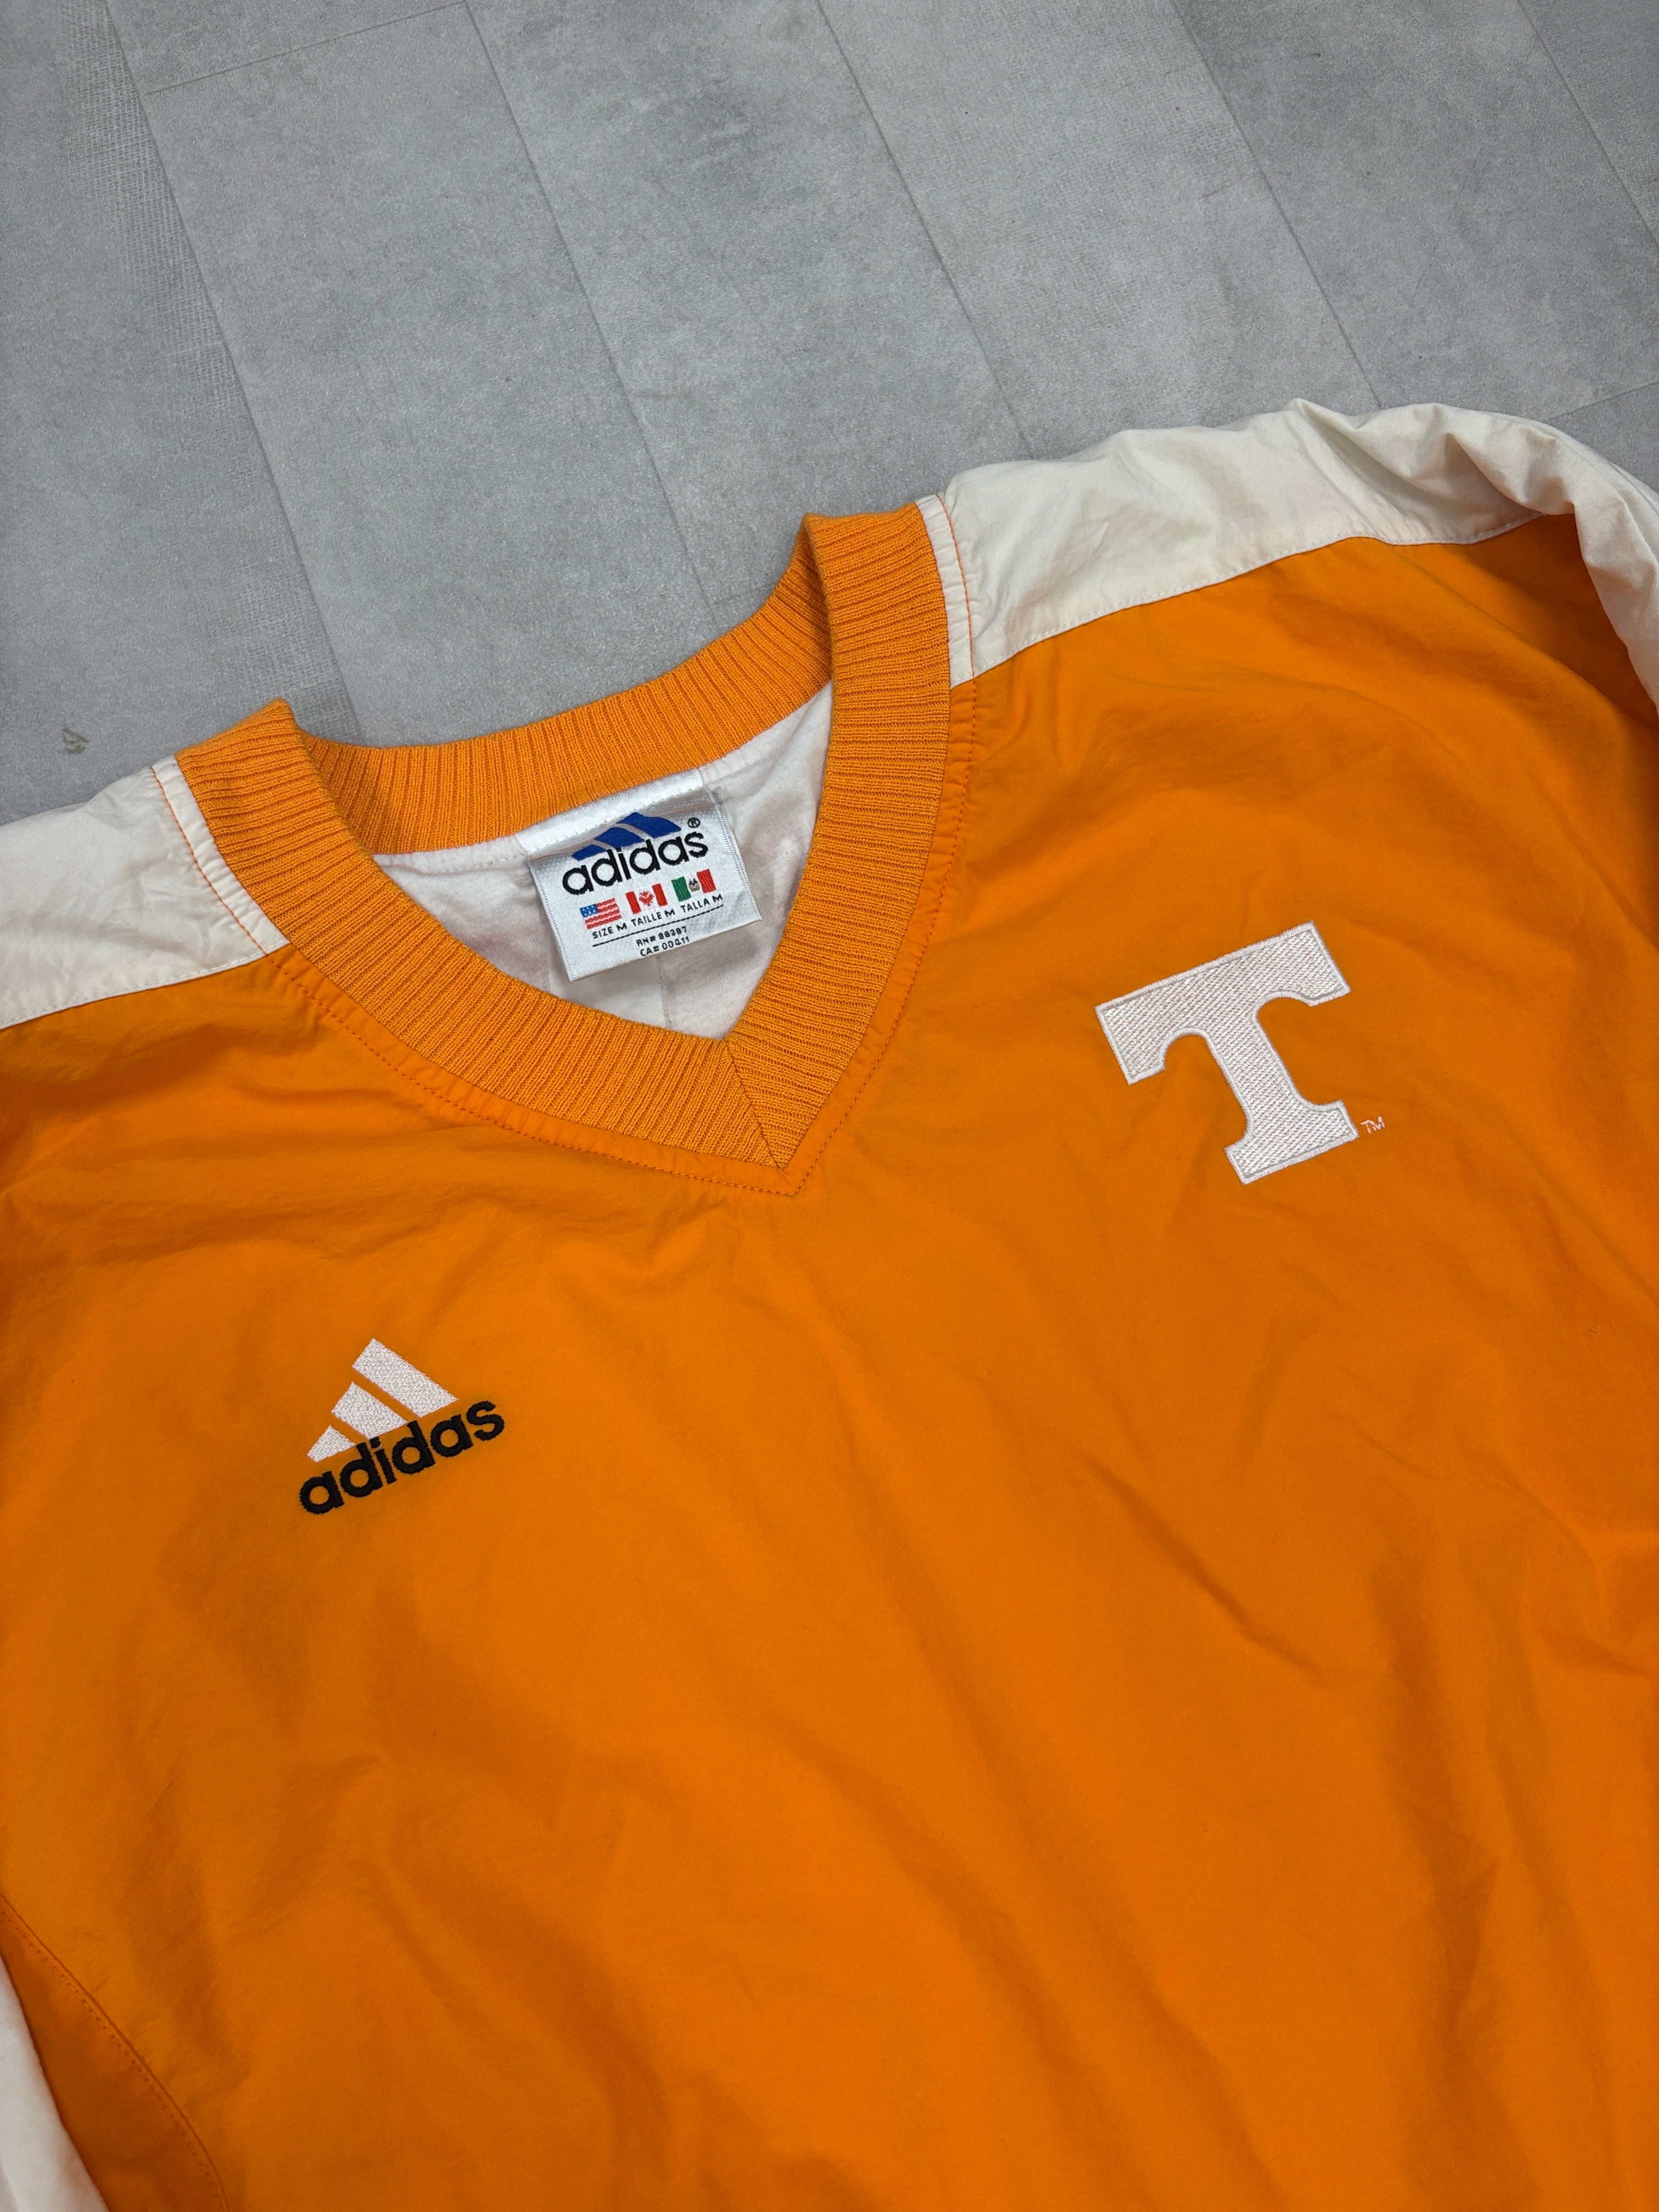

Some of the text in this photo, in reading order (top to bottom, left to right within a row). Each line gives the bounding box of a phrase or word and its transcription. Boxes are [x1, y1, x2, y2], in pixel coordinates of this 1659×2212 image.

[562, 832, 708, 895] adidas
[592, 893, 723, 939] SIZE M TAILLE M TALLA M
[636, 935, 656, 947] RN#
[1094, 919, 1360, 1185] T
[1360, 1115, 1386, 1134] TM
[299, 1401, 505, 1515] adidas
